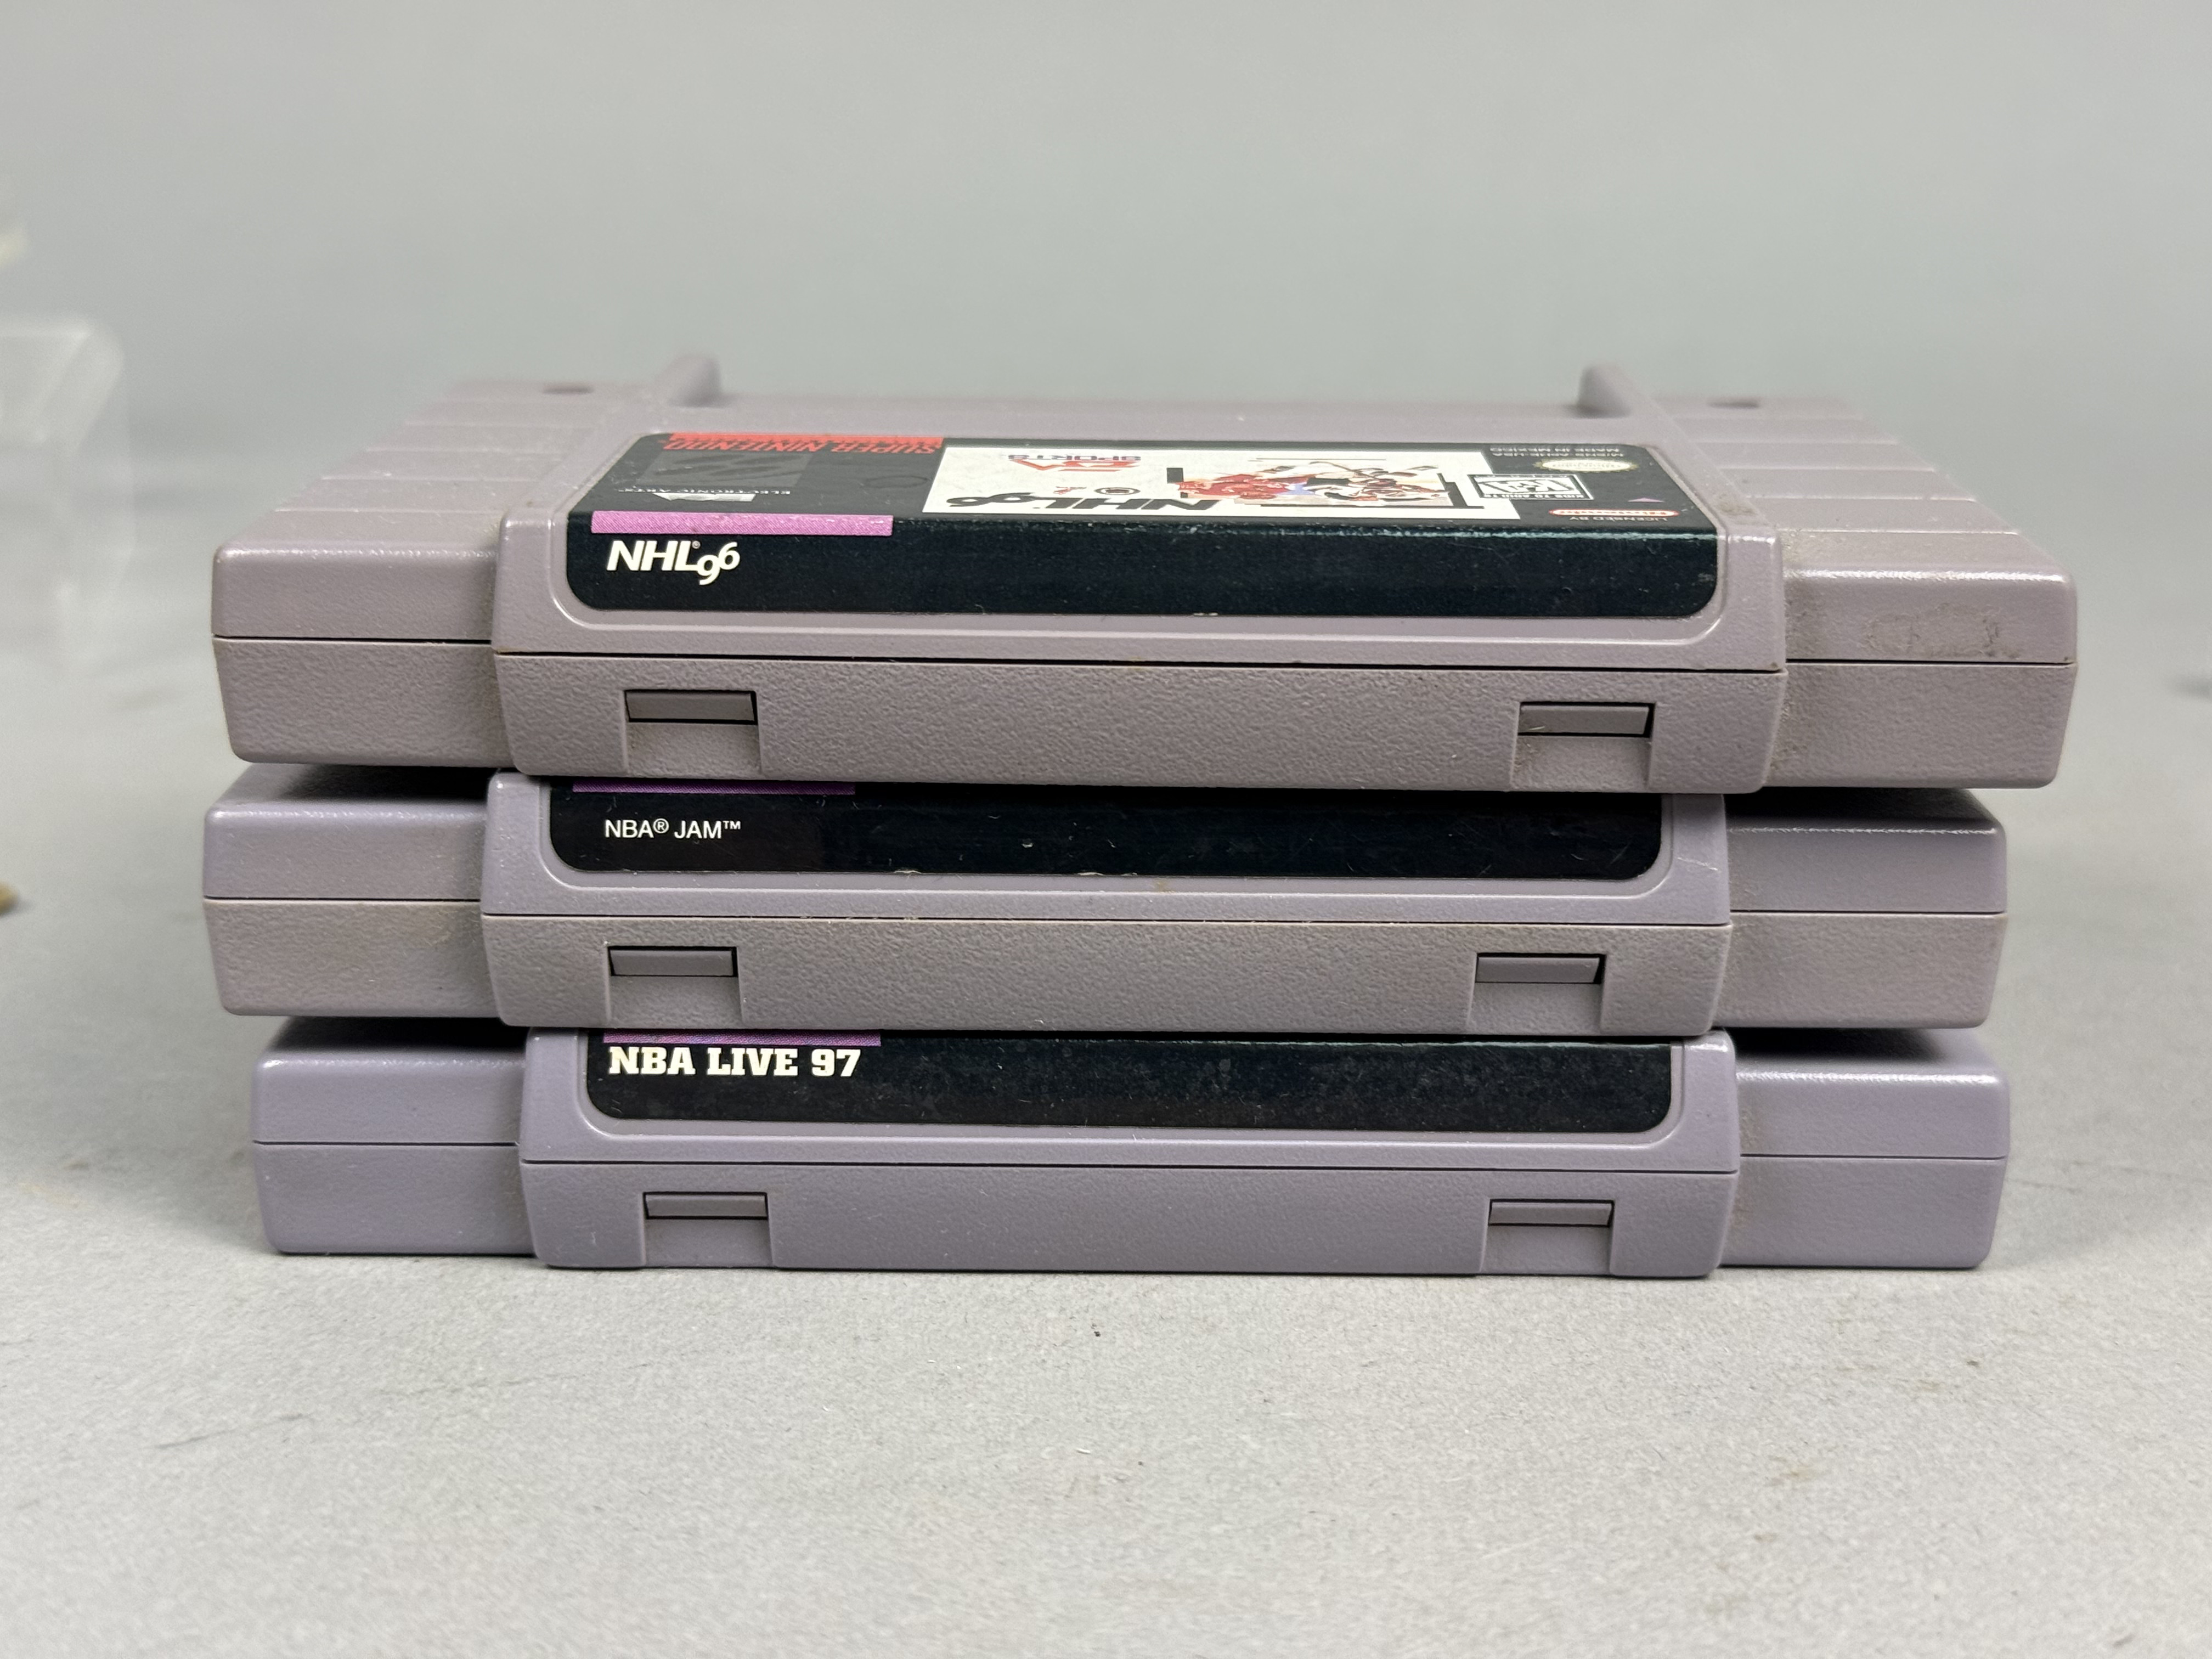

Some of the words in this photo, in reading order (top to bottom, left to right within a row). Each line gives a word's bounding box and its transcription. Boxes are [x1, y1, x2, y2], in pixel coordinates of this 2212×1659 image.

[663, 439, 828, 452] NINTENDO
[830, 441, 939, 454] SUPER
[1008, 460, 1140, 472] EA
[608, 1046, 696, 1075] NBA
[707, 1047, 798, 1076] LIVE
[811, 1048, 861, 1077] 97
